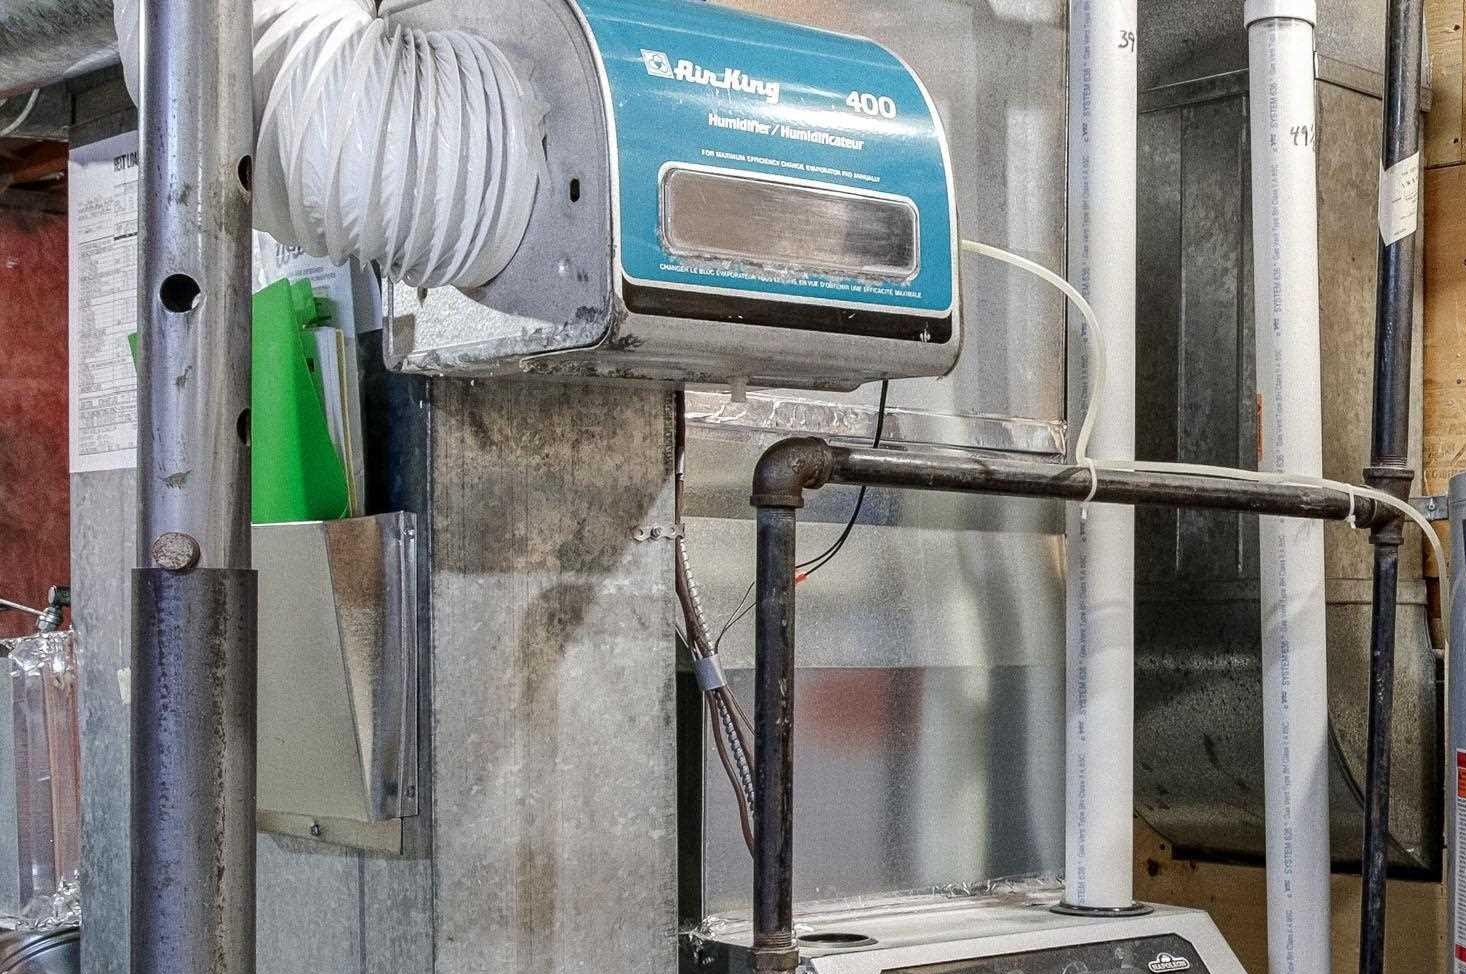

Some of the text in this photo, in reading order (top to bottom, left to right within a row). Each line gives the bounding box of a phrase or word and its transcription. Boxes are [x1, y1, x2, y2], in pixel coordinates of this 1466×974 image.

[846, 91, 896, 119] 400
[1082, 84, 1090, 116] SYSTEM
[1270, 98, 1278, 128] SYSTEM
[708, 113, 769, 134] Humidifier
[781, 126, 864, 150] Humidificateur
[1272, 282, 1282, 311] SYSTEM
[1280, 657, 1289, 686] SYSTEM
[1079, 682, 1088, 714] SYSTEM
[1284, 842, 1292, 874] SYSTEM
